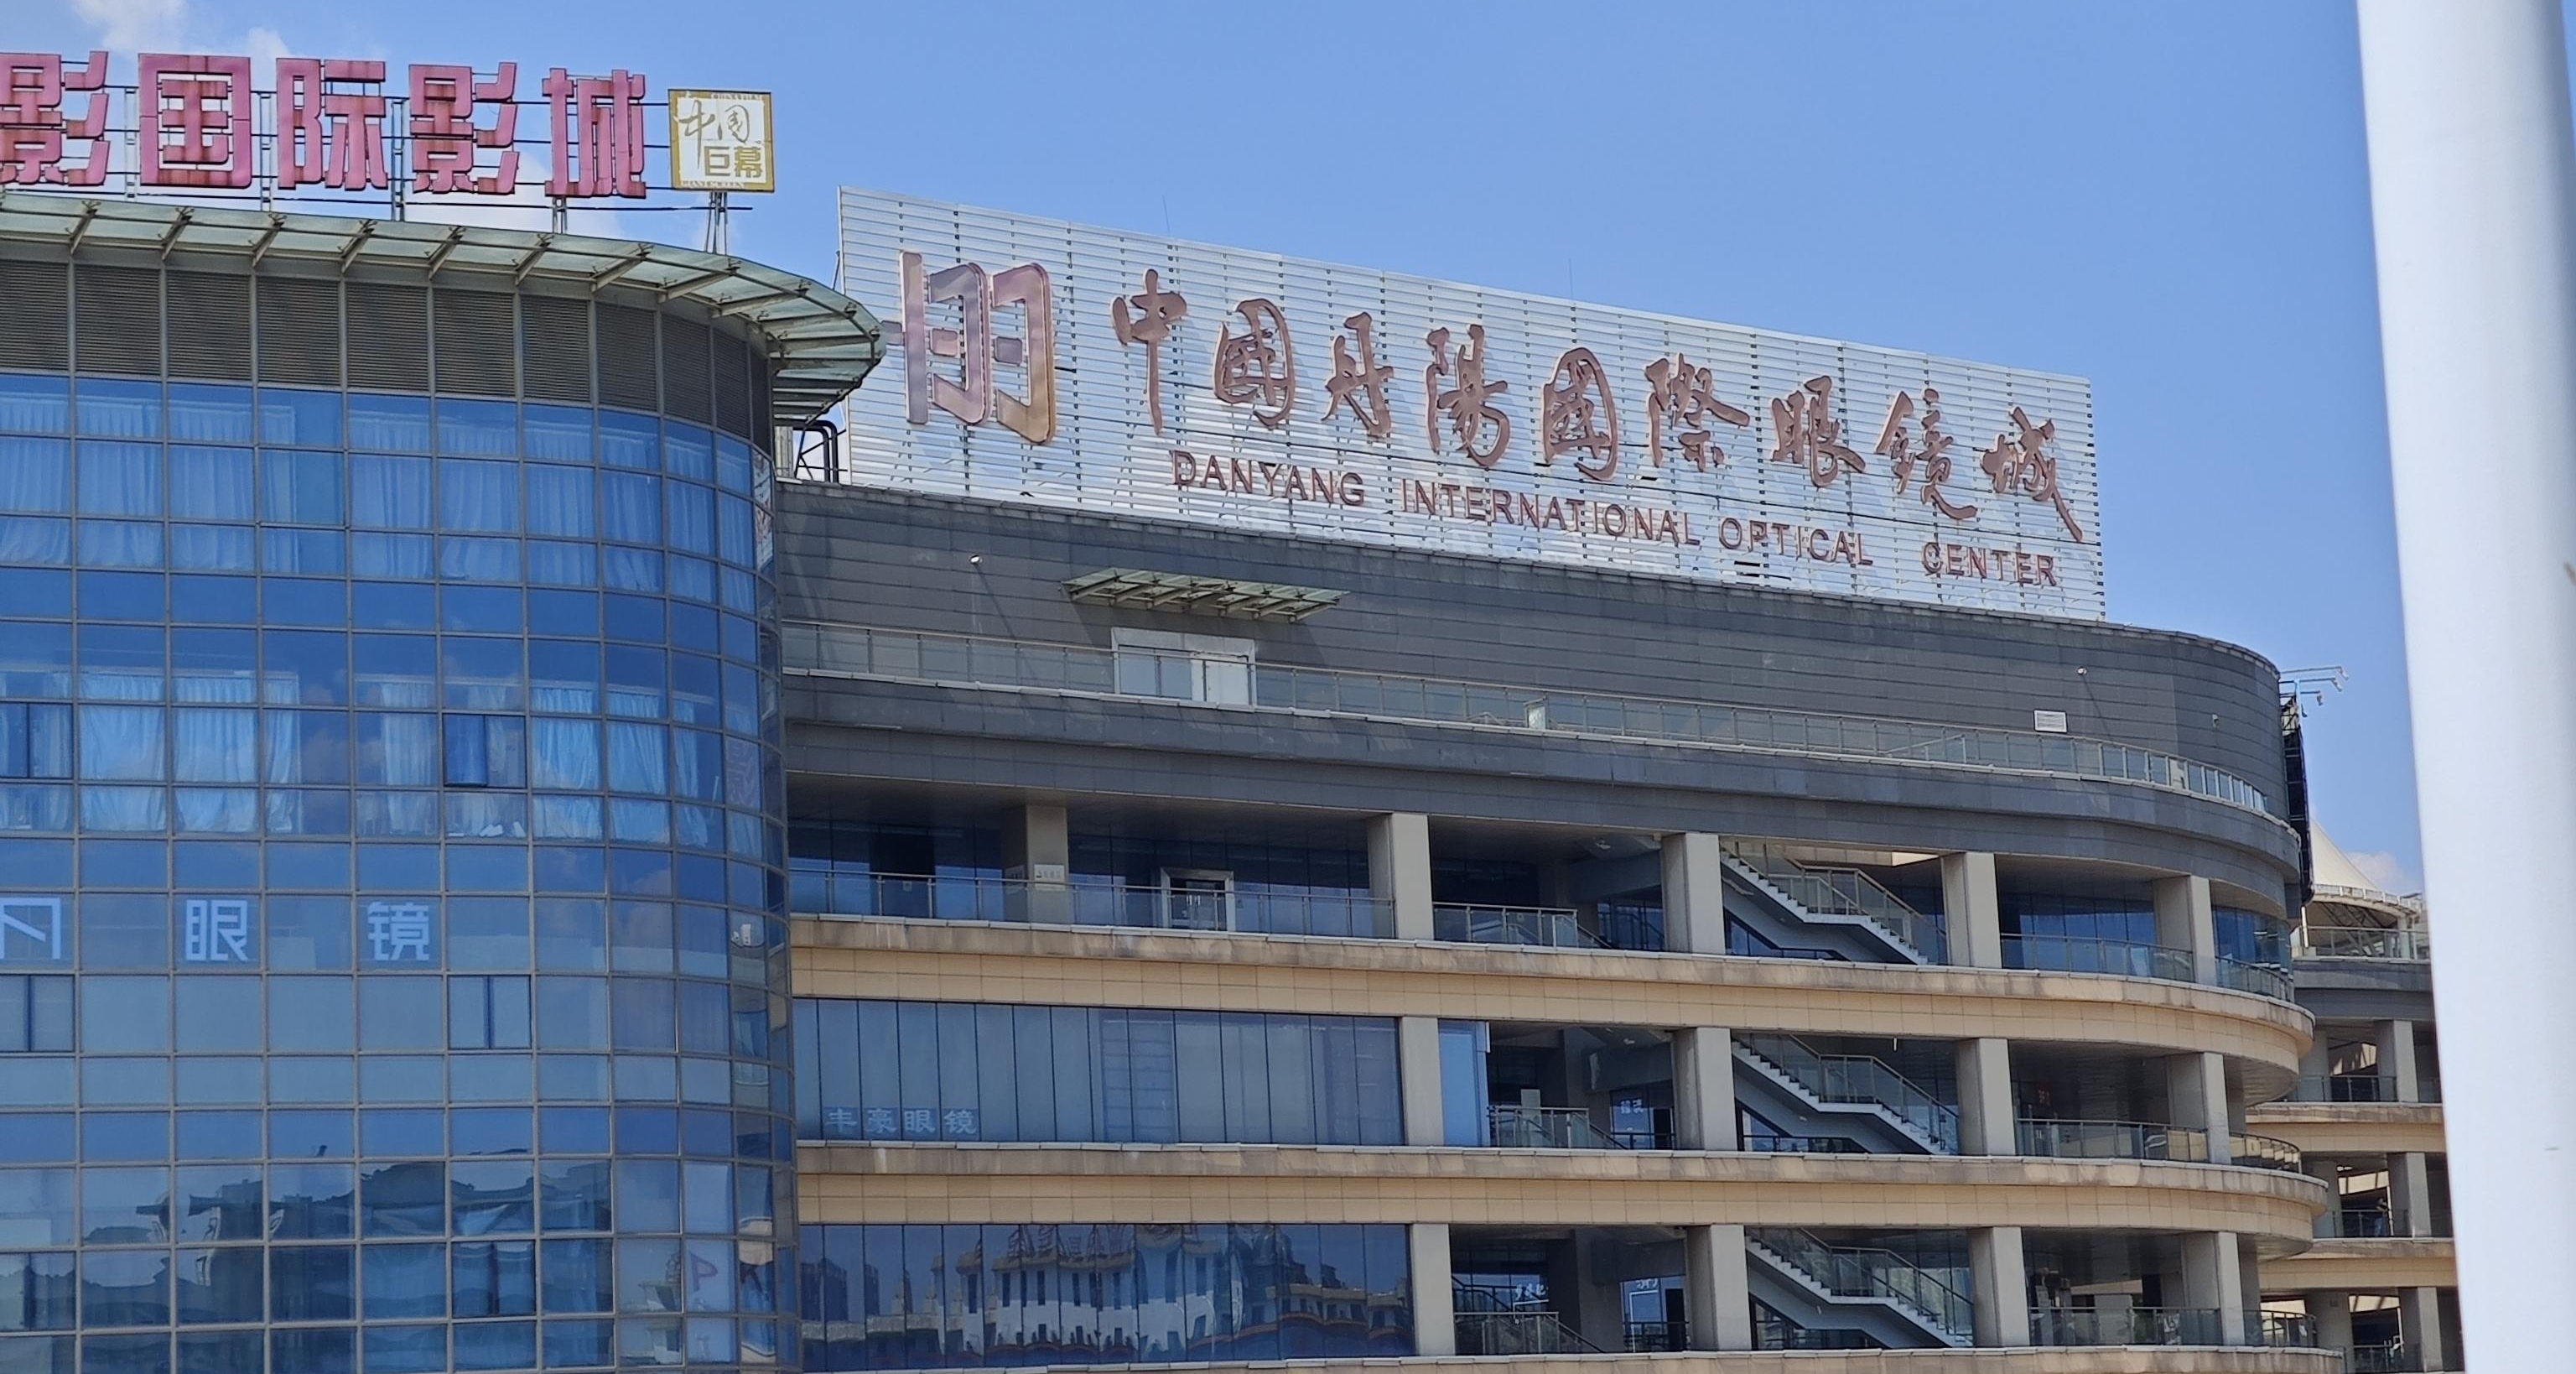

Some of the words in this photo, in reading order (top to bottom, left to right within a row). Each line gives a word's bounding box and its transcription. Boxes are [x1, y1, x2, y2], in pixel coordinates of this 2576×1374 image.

[704, 146, 763, 178] 巨幕
[1171, 449, 1366, 507] DANYANG
[1401, 478, 1701, 547] INTERNATIONAL
[1718, 517, 1873, 566] OPTICAL
[1921, 541, 2057, 586] CENTER
